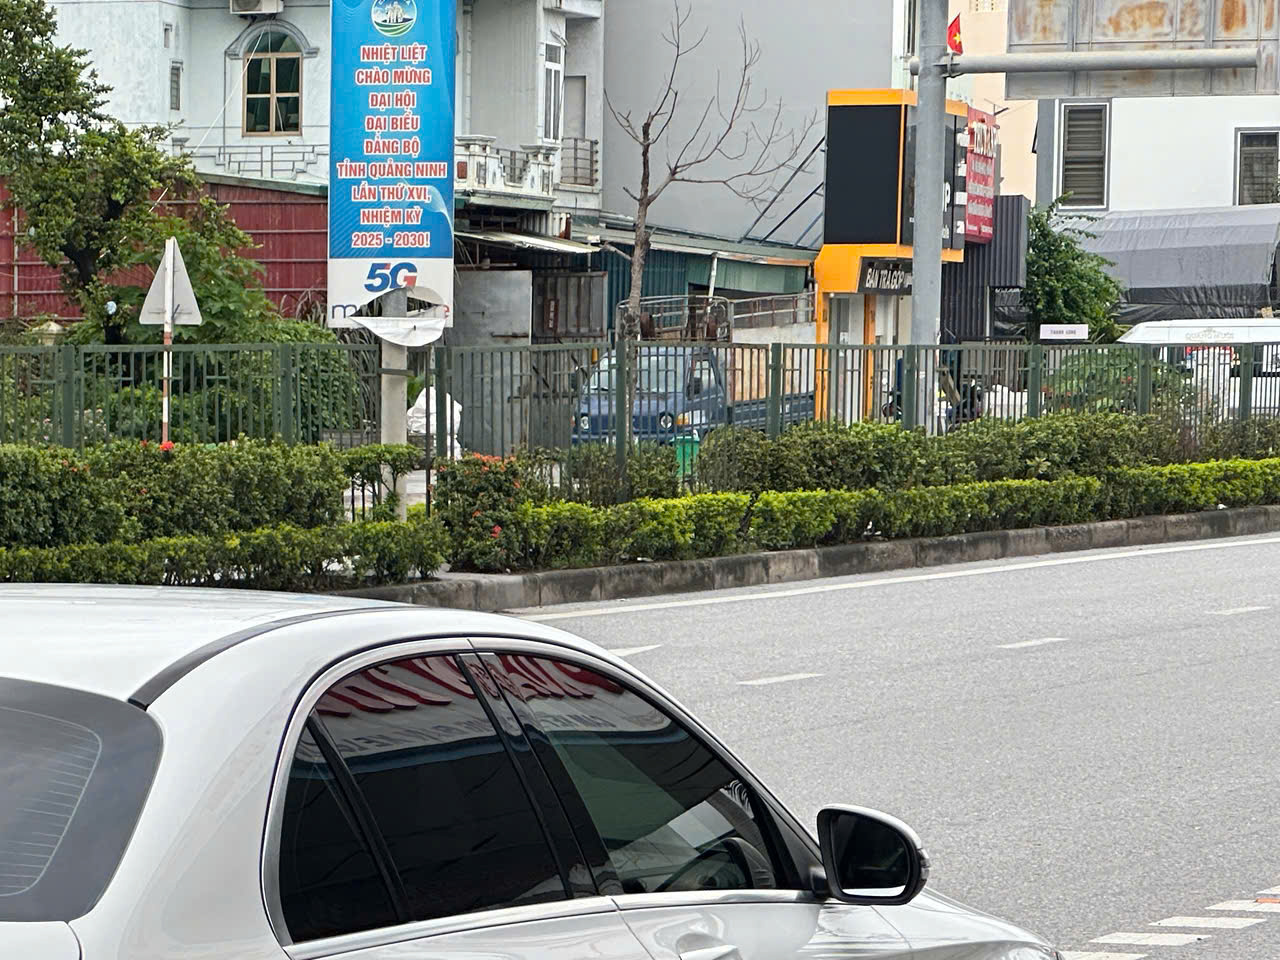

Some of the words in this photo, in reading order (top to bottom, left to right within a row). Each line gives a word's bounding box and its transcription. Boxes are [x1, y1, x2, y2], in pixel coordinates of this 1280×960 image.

[361, 43, 398, 64] NHIỆT
[401, 43, 426, 64] LIỆT
[356, 66, 390, 84] CHÀO
[393, 66, 431, 84] MỪNG
[370, 93, 391, 111] ĐẠI
[395, 90, 416, 111] HỘI
[366, 116, 387, 133] ĐẠI
[391, 110, 419, 130] BIỂU
[365, 134, 399, 154] ĐẢNG
[403, 137, 419, 157] BỘ
[337, 159, 366, 177] TỈNH
[369, 158, 412, 179] QUẢNG
[415, 163, 446, 177] NINH
[380, 183, 405, 200] THỨ
[407, 186, 431, 202] XVI,
[361, 206, 401, 227] NHIỆM
[353, 233, 382, 247] 2025
[395, 233, 430, 247] 2030!
[364, 262, 418, 293] 5G
